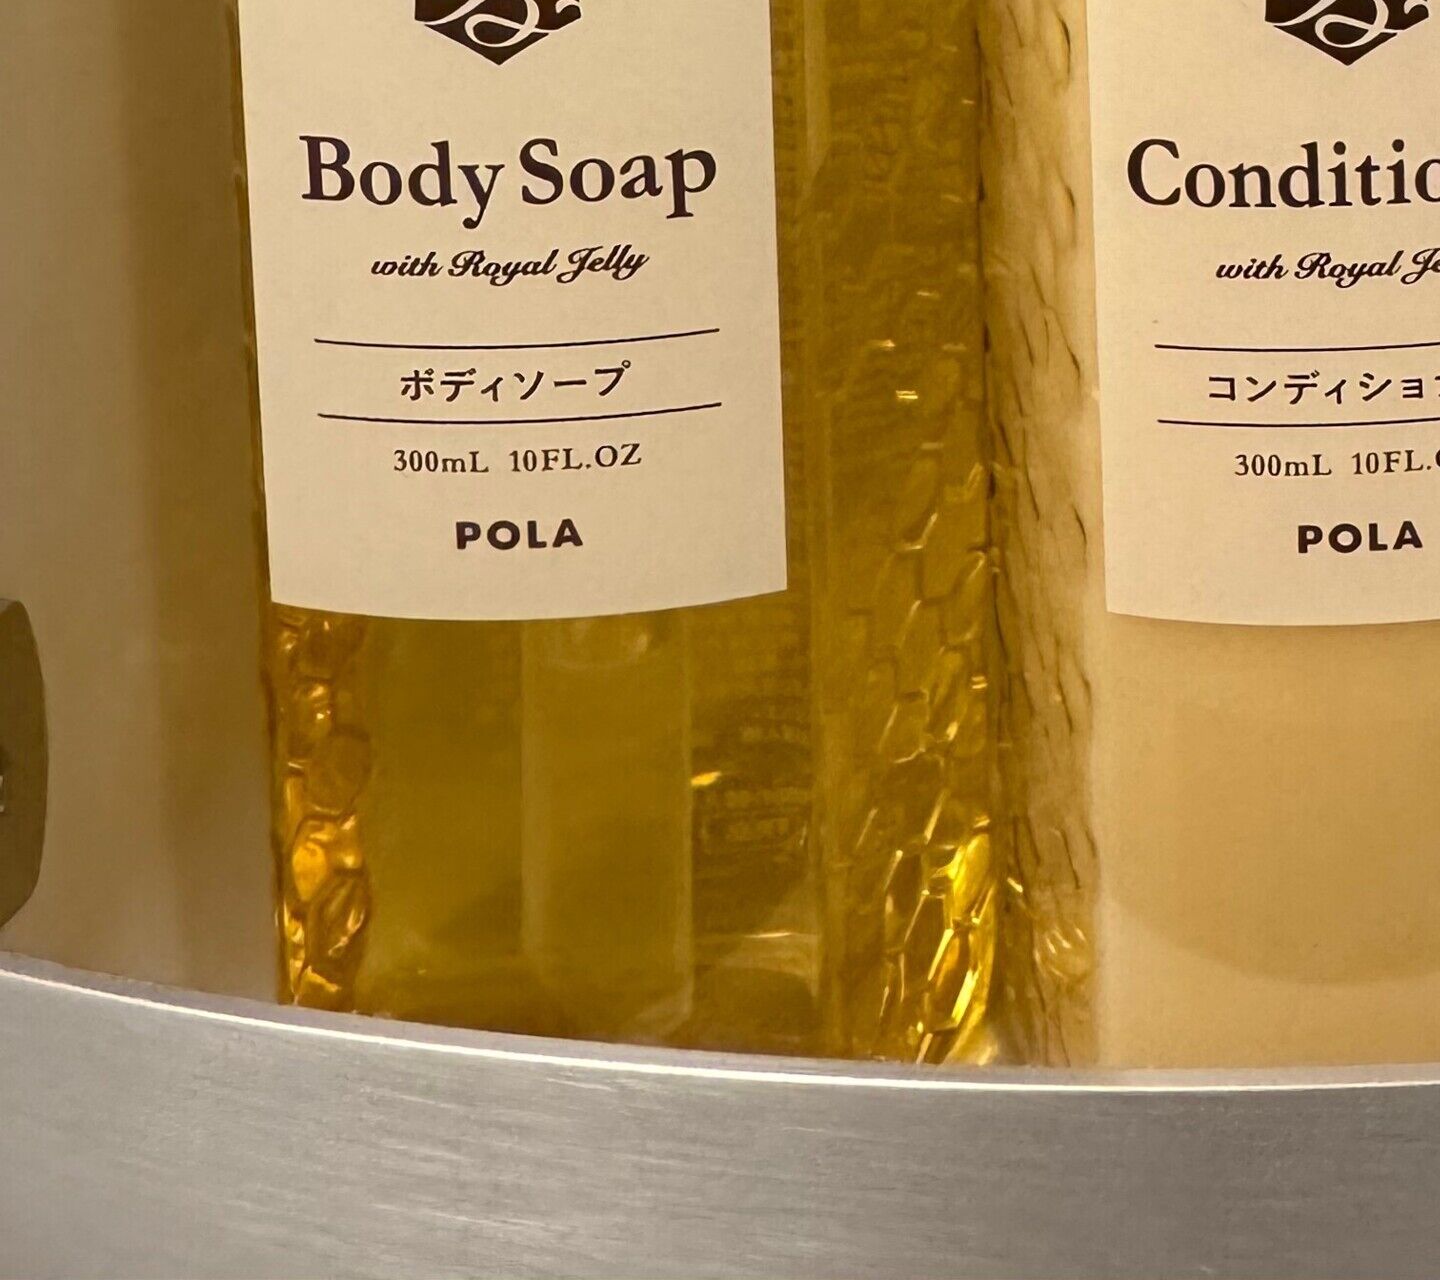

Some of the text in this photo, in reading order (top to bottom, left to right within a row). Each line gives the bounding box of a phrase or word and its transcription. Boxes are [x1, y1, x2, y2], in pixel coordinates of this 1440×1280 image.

[298, 135, 717, 230] Body Soap
[370, 244, 650, 287] with Royal Jelly
[1215, 253, 1289, 280] with
[1293, 249, 1404, 289] Royal
[400, 359, 632, 403] ボディソープ
[393, 443, 642, 473] 300mL 10FL.OZ
[1234, 453, 1333, 477] 300mL
[455, 518, 584, 551] POLA
[1297, 520, 1423, 554] POLA
